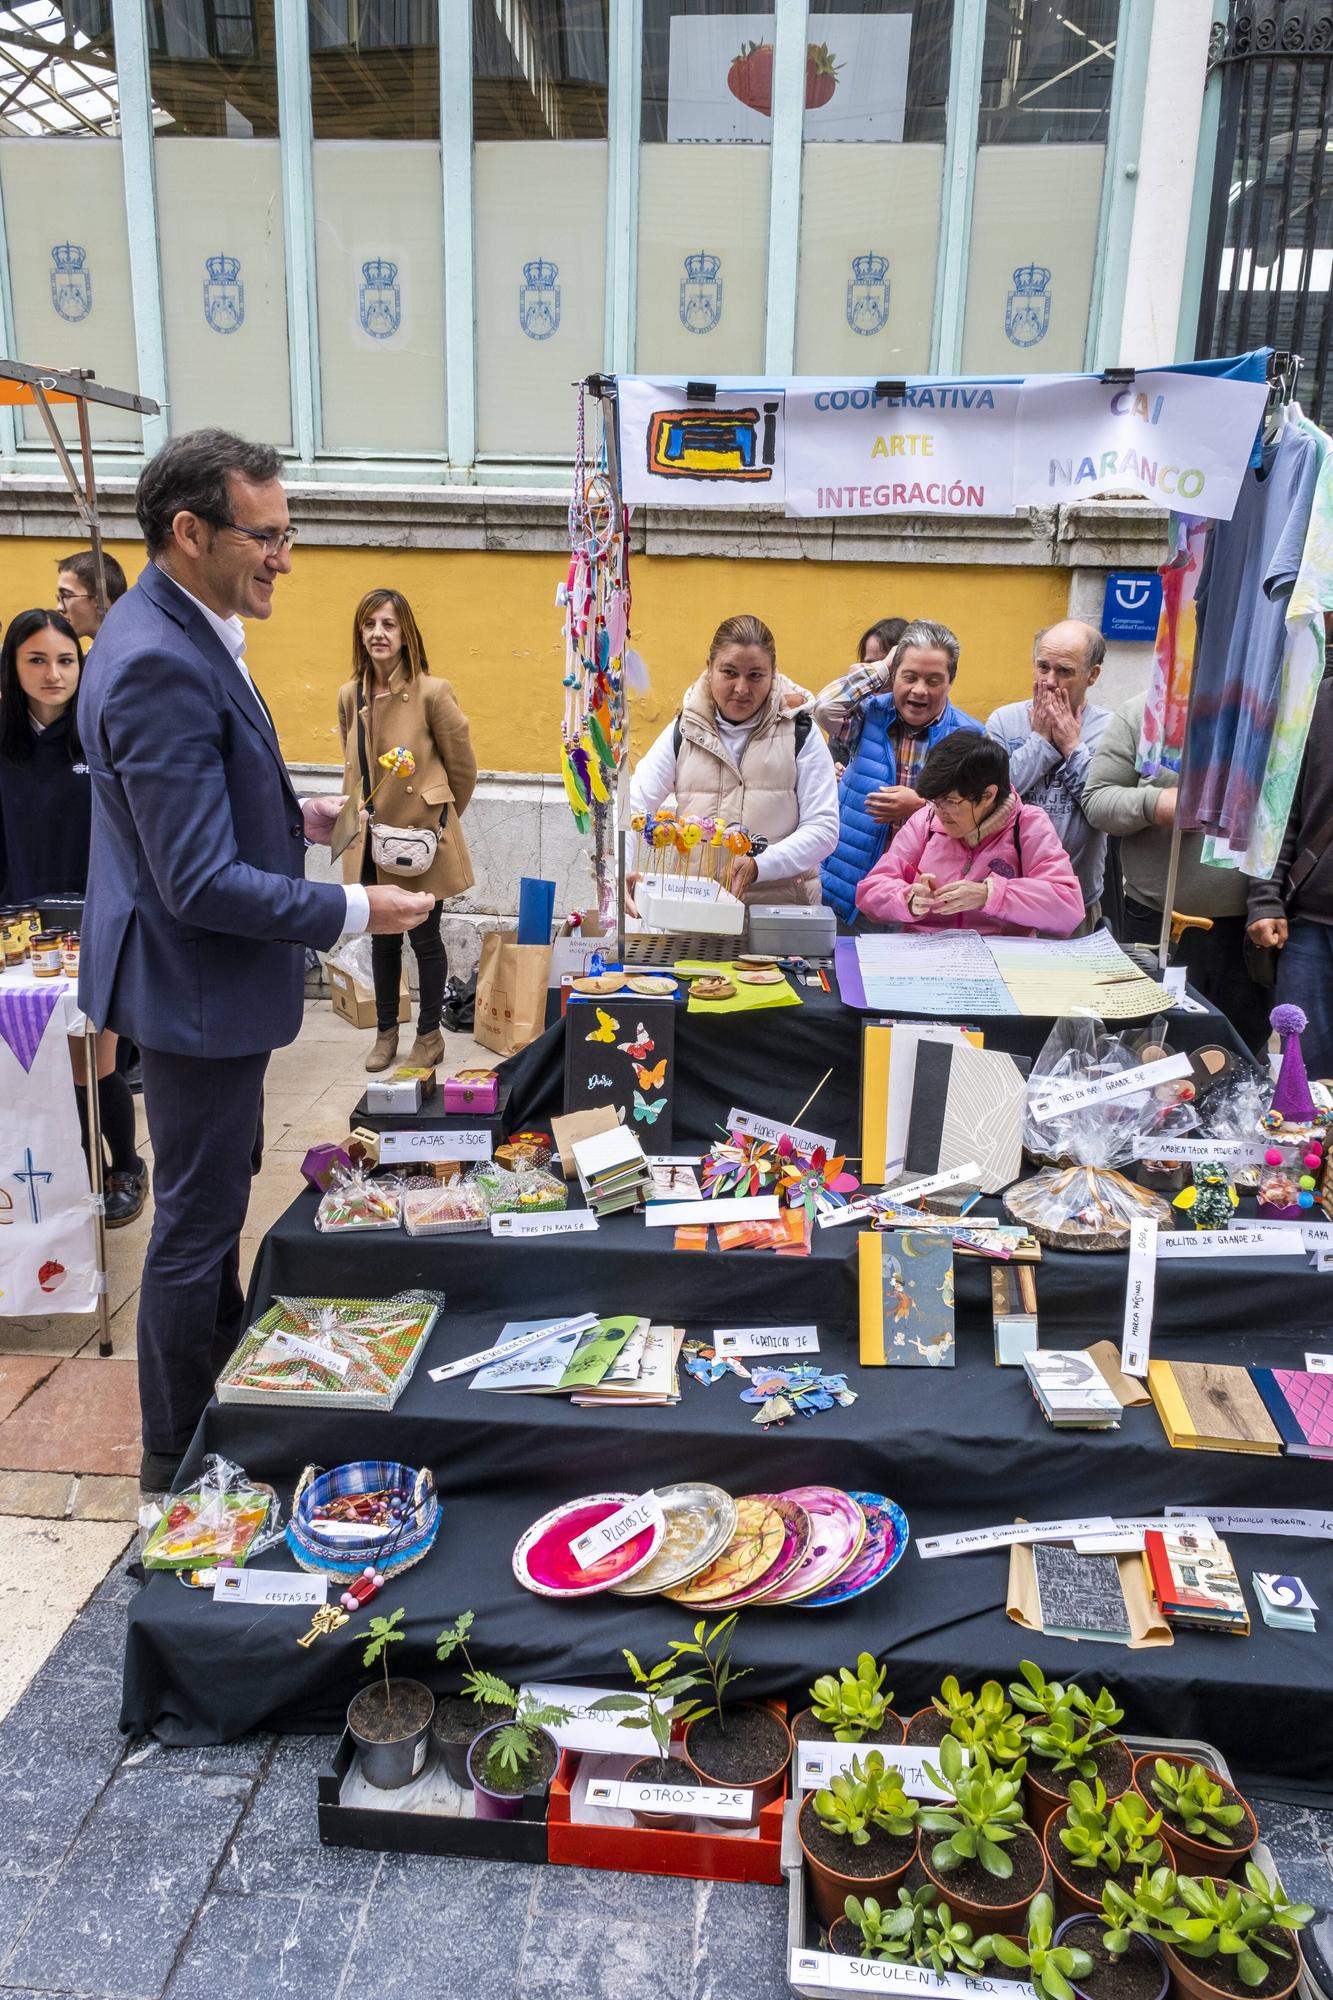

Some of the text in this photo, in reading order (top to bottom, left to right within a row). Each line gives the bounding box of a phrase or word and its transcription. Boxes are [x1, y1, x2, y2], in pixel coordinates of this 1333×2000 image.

[813, 388, 995, 411] COOPERATIVA
[1111, 390, 1165, 425] CAI
[870, 433, 935, 458] ARTE
[1048, 448, 1206, 499] NARANCO
[817, 480, 985, 509] INTEGRACIÓN
[1105, 1077, 1131, 1091] GRANDE
[411, 1135, 446, 1147] CAJAS
[521, 1225, 539, 1233] TRES
[542, 1224, 553, 1233] EN
[554, 1224, 572, 1232] RAYA
[1165, 1233, 1264, 1247] POLLITOS 2€ GRANDE 2€
[1308, 1229, 1329, 1241] RAYA
[1131, 1313, 1140, 1337] MARCA
[601, 1515, 637, 1542] PLATOS
[265, 1592, 301, 1603] CESTAS
[639, 1788, 695, 1804] OTROS
[716, 1792, 744, 1806] 2€
[849, 1961, 951, 1987] SUCULENTA
